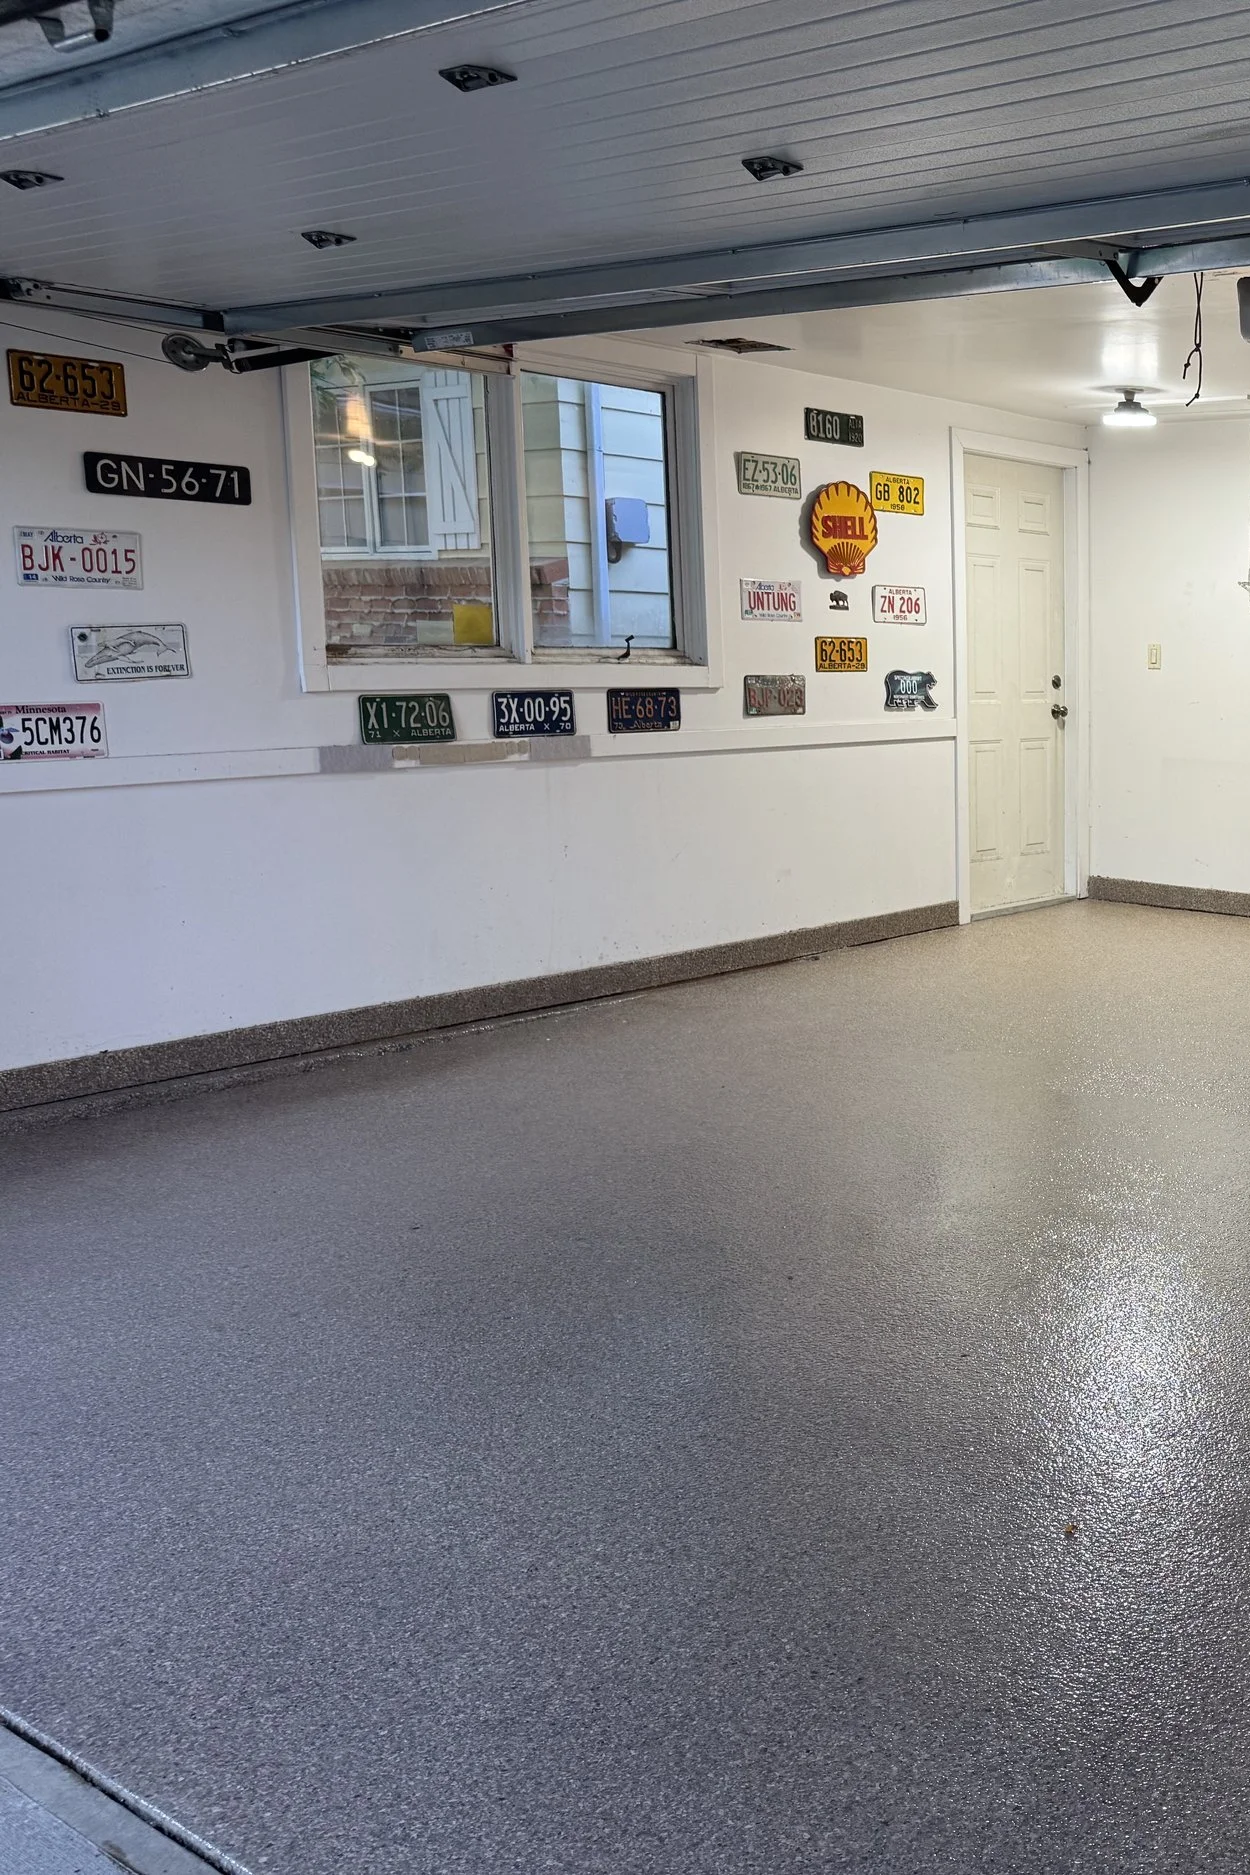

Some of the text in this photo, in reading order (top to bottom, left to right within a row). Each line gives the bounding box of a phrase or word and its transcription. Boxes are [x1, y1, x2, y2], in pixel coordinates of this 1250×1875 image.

[885, 477, 910, 485] ALBERTA
[875, 482, 920, 505] GB 802
[821, 515, 869, 540] SHELL
[43, 530, 84, 544] Alberta
[86, 576, 111, 584] Country
[748, 591, 797, 611] UNTUNG
[880, 595, 921, 614] ZN 206
[106, 664, 186, 675] EXTINCTION IS FOREVER
[15, 705, 67, 715] Minnesota
[21, 715, 102, 746] 5CM376
[498, 723, 535, 732] ALBERTA
[559, 722, 572, 730] 70
[368, 730, 382, 739] 71
[410, 728, 452, 737] ALBERTA
